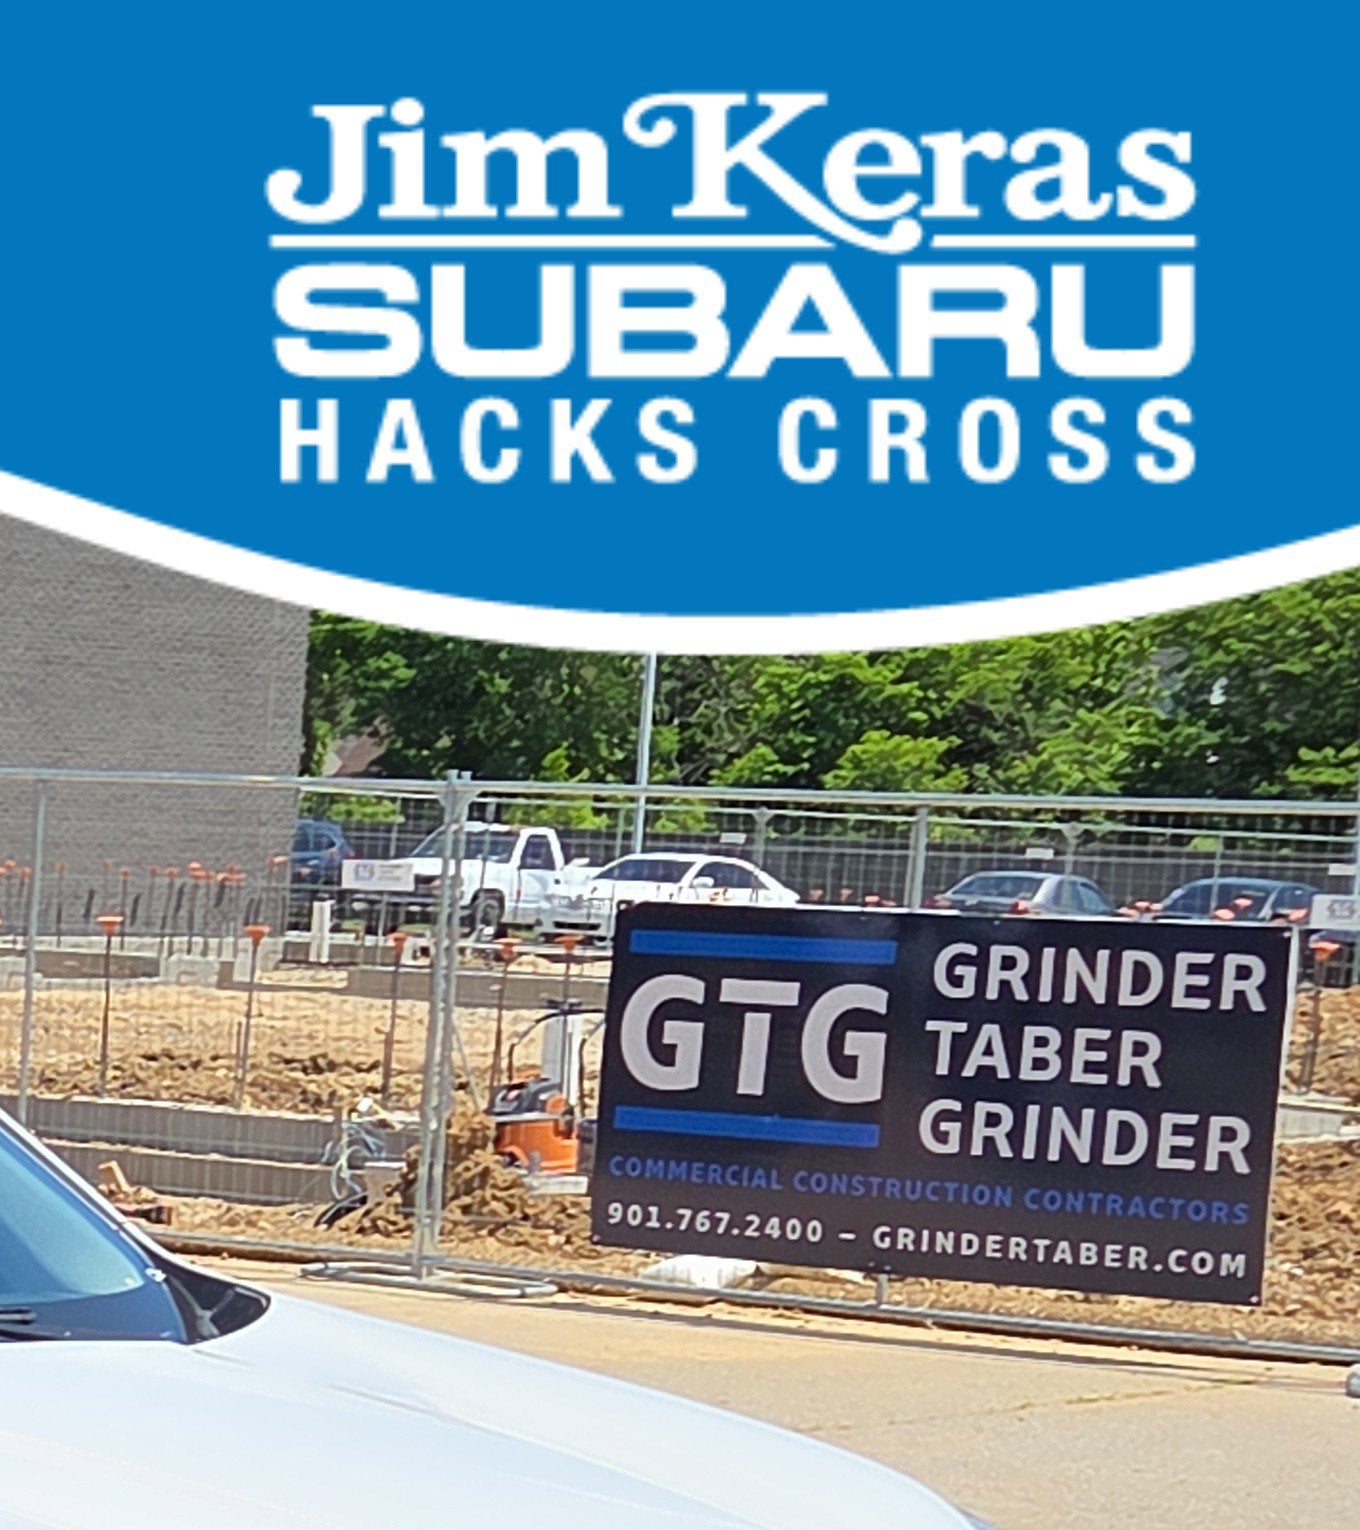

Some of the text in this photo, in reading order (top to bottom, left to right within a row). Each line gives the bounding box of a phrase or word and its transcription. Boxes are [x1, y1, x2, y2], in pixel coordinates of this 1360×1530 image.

[933, 942, 1267, 1012] GRINDER
[619, 974, 889, 1104] GTG
[924, 1020, 1162, 1088] TABER
[918, 1098, 1251, 1175] GRINDER
[608, 1154, 1251, 1226] COMMERCIAL CONSTRUCTION CONTRACTORS
[607, 1202, 823, 1243] 901.767.2400
[872, 1225, 1246, 1279] GRINDERTABER.COM
